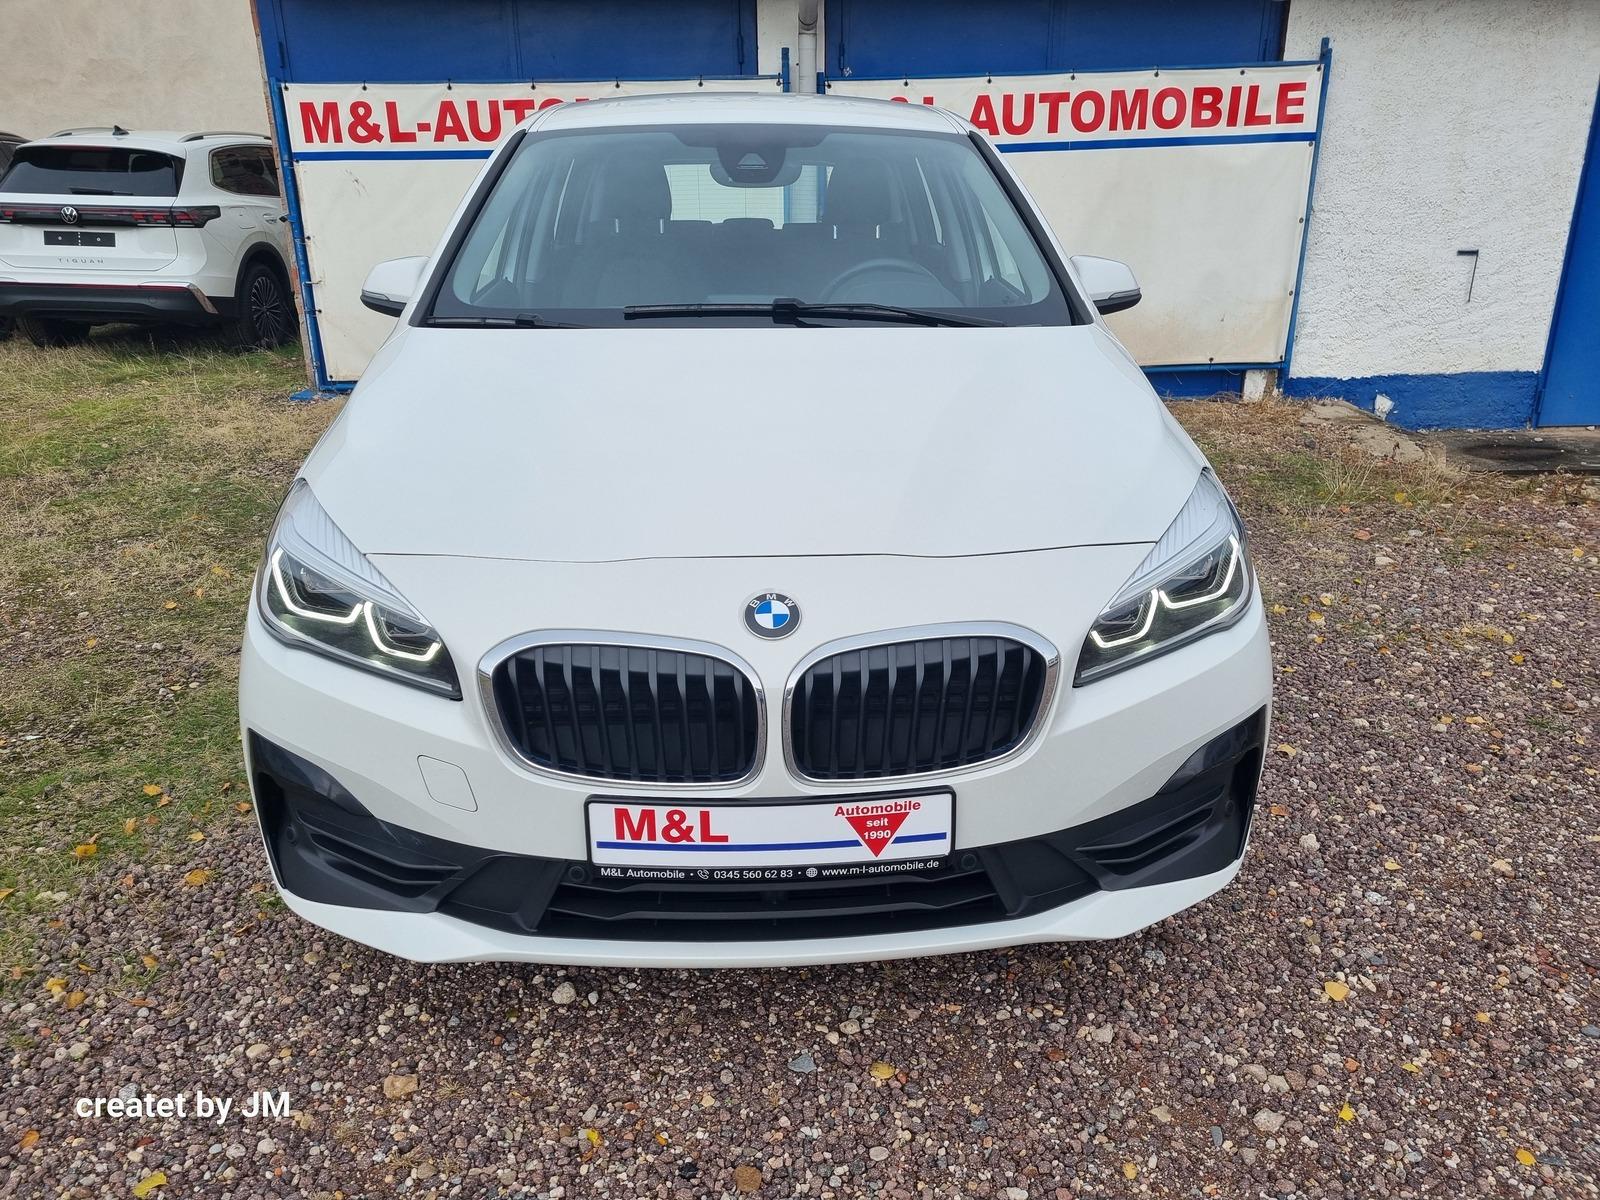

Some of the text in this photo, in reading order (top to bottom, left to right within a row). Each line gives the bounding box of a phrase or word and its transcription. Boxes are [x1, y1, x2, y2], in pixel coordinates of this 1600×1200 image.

[58, 256, 104, 264] TIGUAN
[749, 593, 795, 608] BMW
[834, 800, 921, 817] Automobile
[614, 807, 729, 843] M&L
[866, 817, 888, 827] seit
[863, 830, 892, 840] 1990
[600, 859, 940, 879] M&L Automobile 0345 560 62 83 www.m-l-automobile.de
